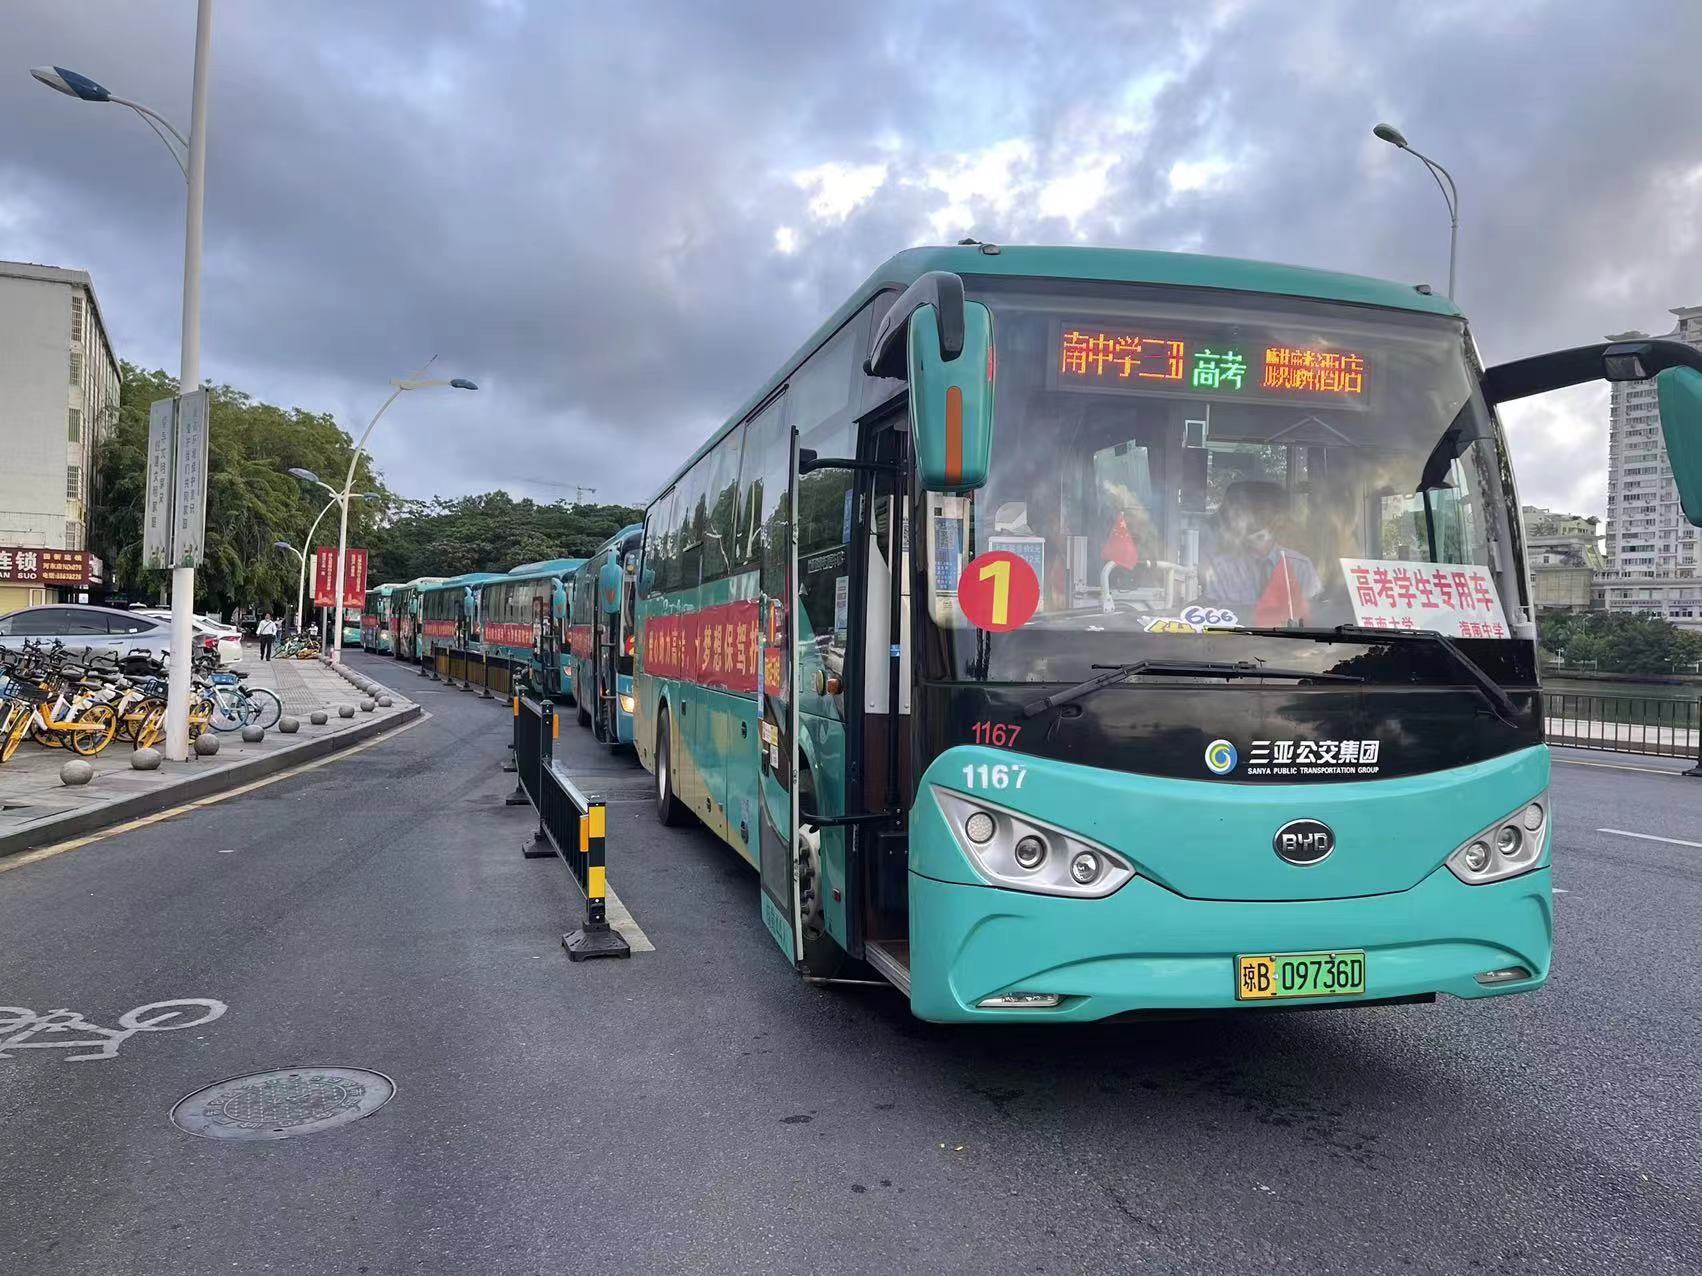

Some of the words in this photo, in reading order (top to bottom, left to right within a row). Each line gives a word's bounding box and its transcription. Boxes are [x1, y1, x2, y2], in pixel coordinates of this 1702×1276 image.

[1192, 349, 1246, 390] 高考
[0, 551, 37, 572] 连锁
[979, 560, 1011, 625] 1
[1351, 565, 1494, 611] 高考学生专用车
[1185, 607, 1233, 624] 666
[971, 721, 1022, 747] 1167
[1249, 740, 1380, 764] 三亚公交集团
[962, 764, 1027, 789] 1167
[1300, 766, 1355, 774] TRANSPORTATION
[1282, 832, 1328, 850] BYD
